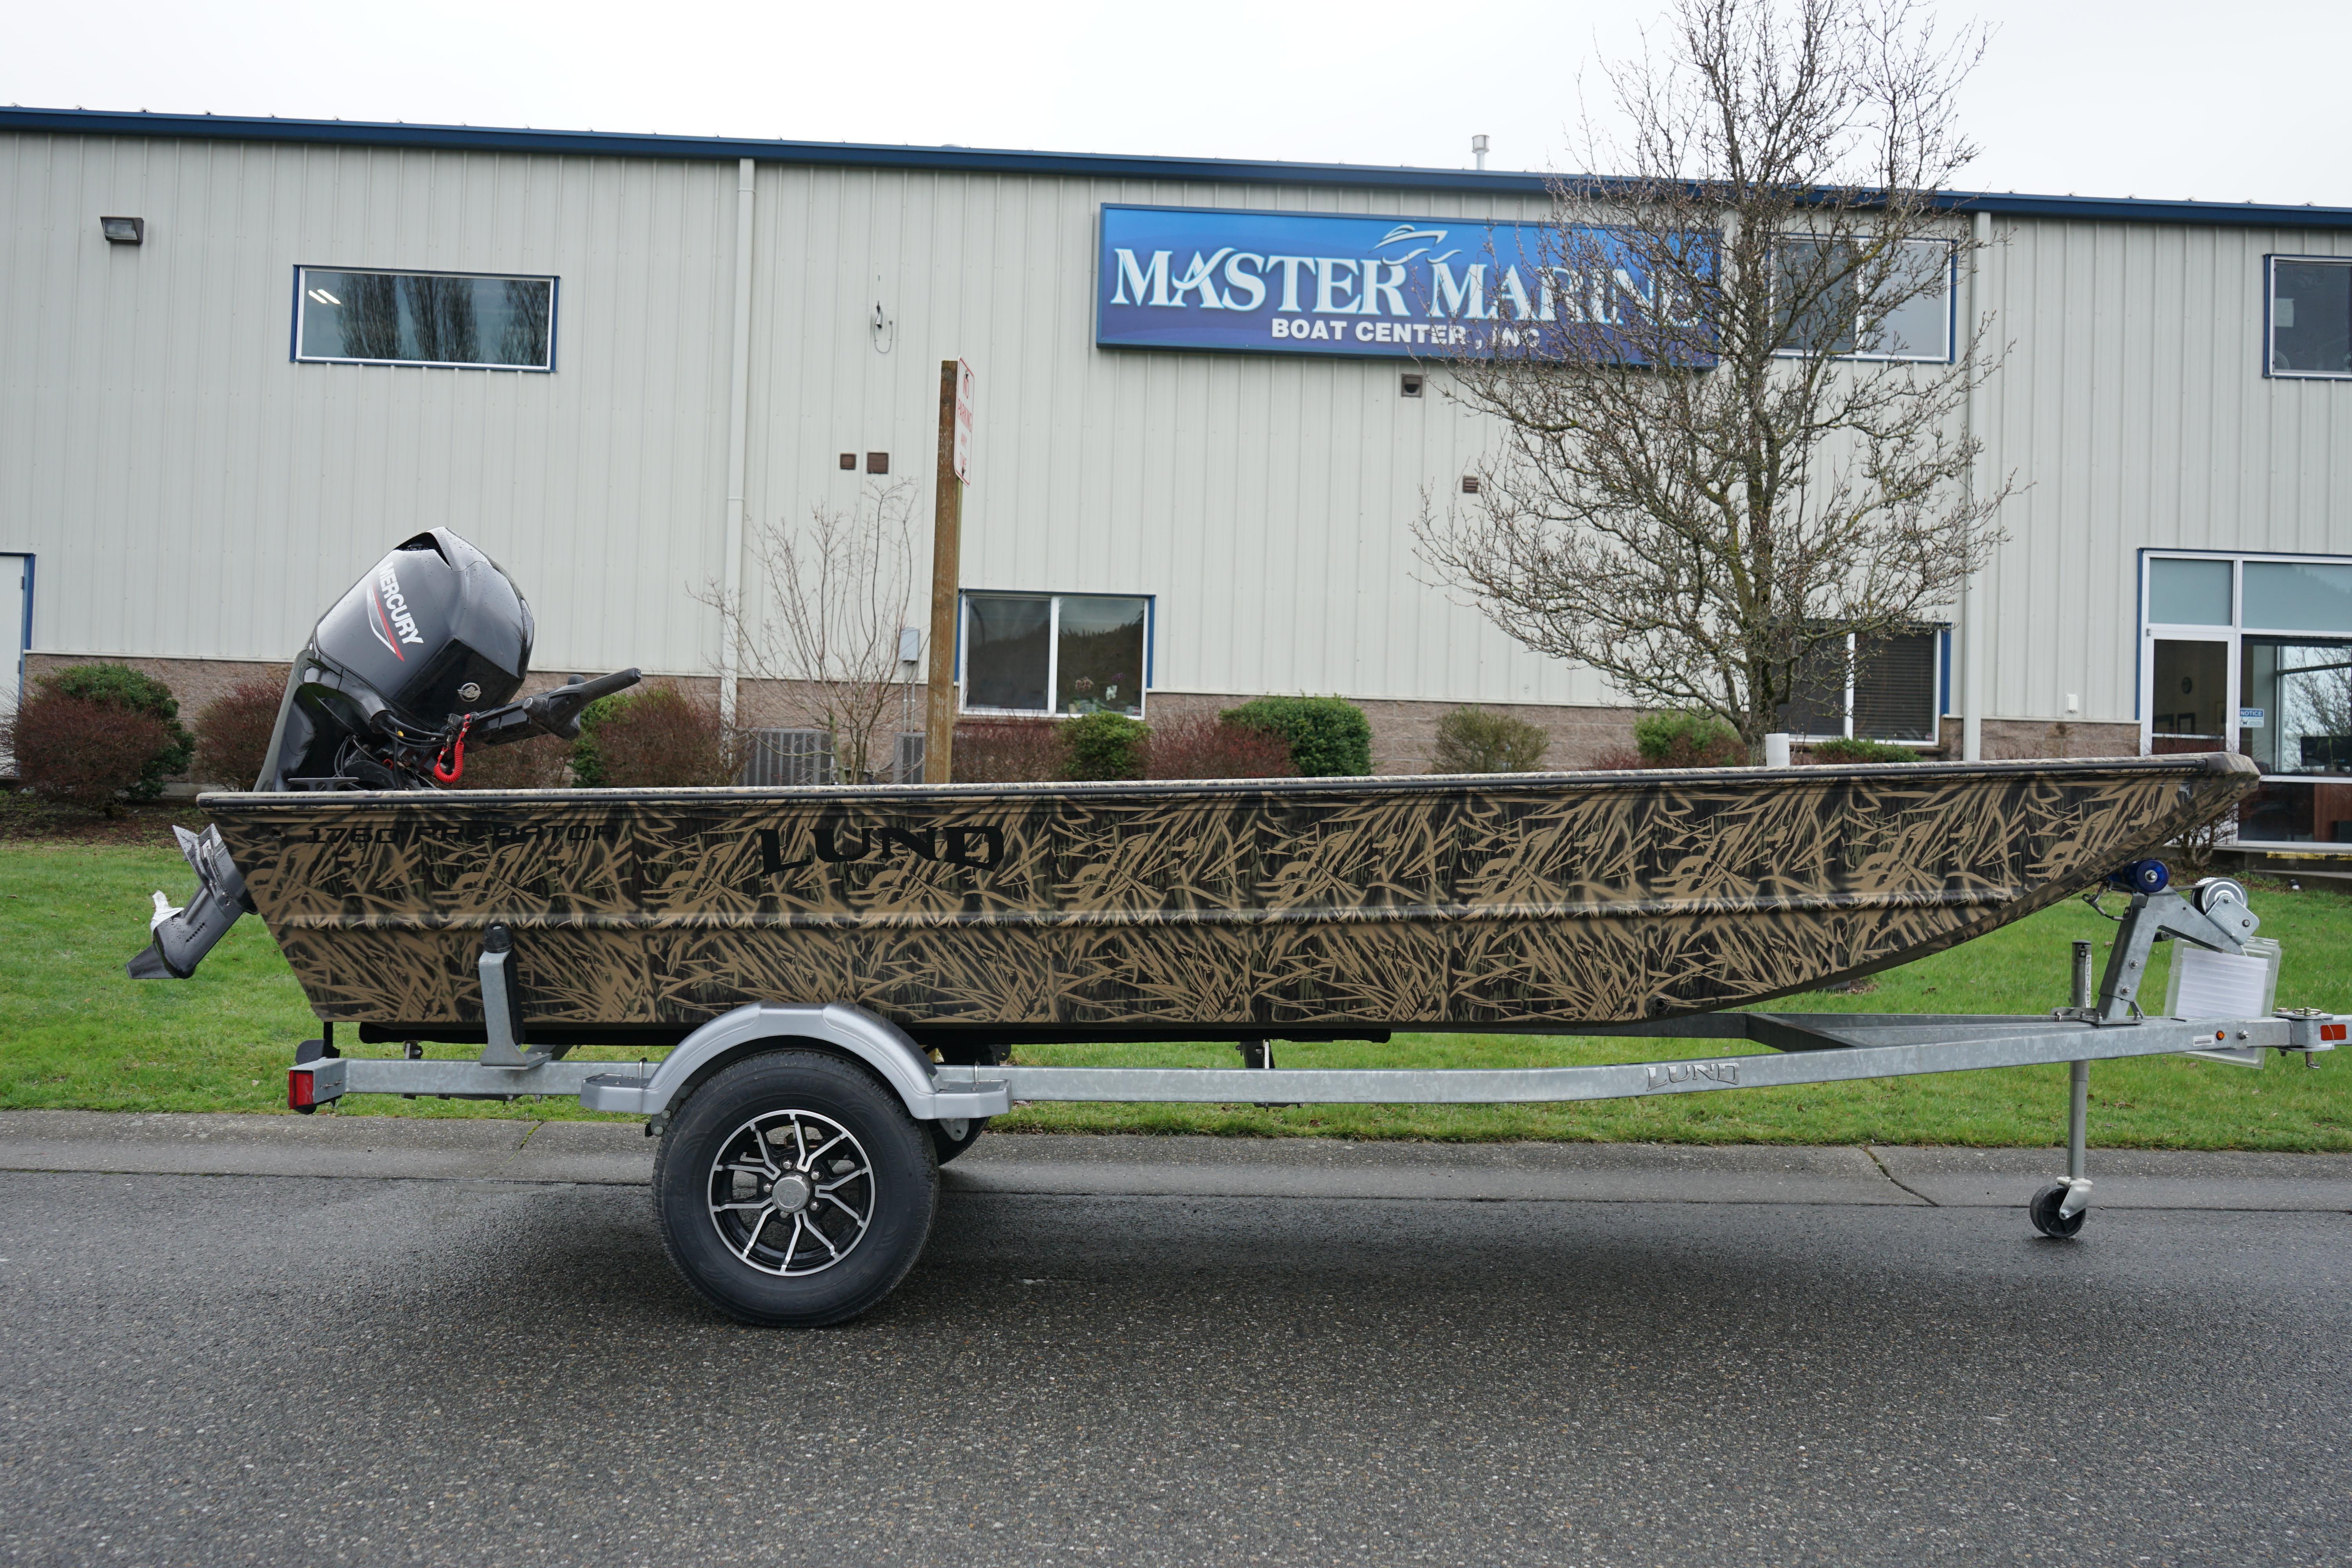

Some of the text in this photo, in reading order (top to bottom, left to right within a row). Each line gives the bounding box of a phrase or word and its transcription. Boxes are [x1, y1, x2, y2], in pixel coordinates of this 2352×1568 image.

[1110, 247, 1411, 317] MASTER
[1272, 318, 1347, 340] BOAT
[963, 374, 969, 399] NO
[379, 561, 424, 644] MERCURY
[305, 824, 617, 845] 1760 PREDATOR
[755, 826, 1004, 877] LUND
[1646, 1062, 1740, 1091] LUND
